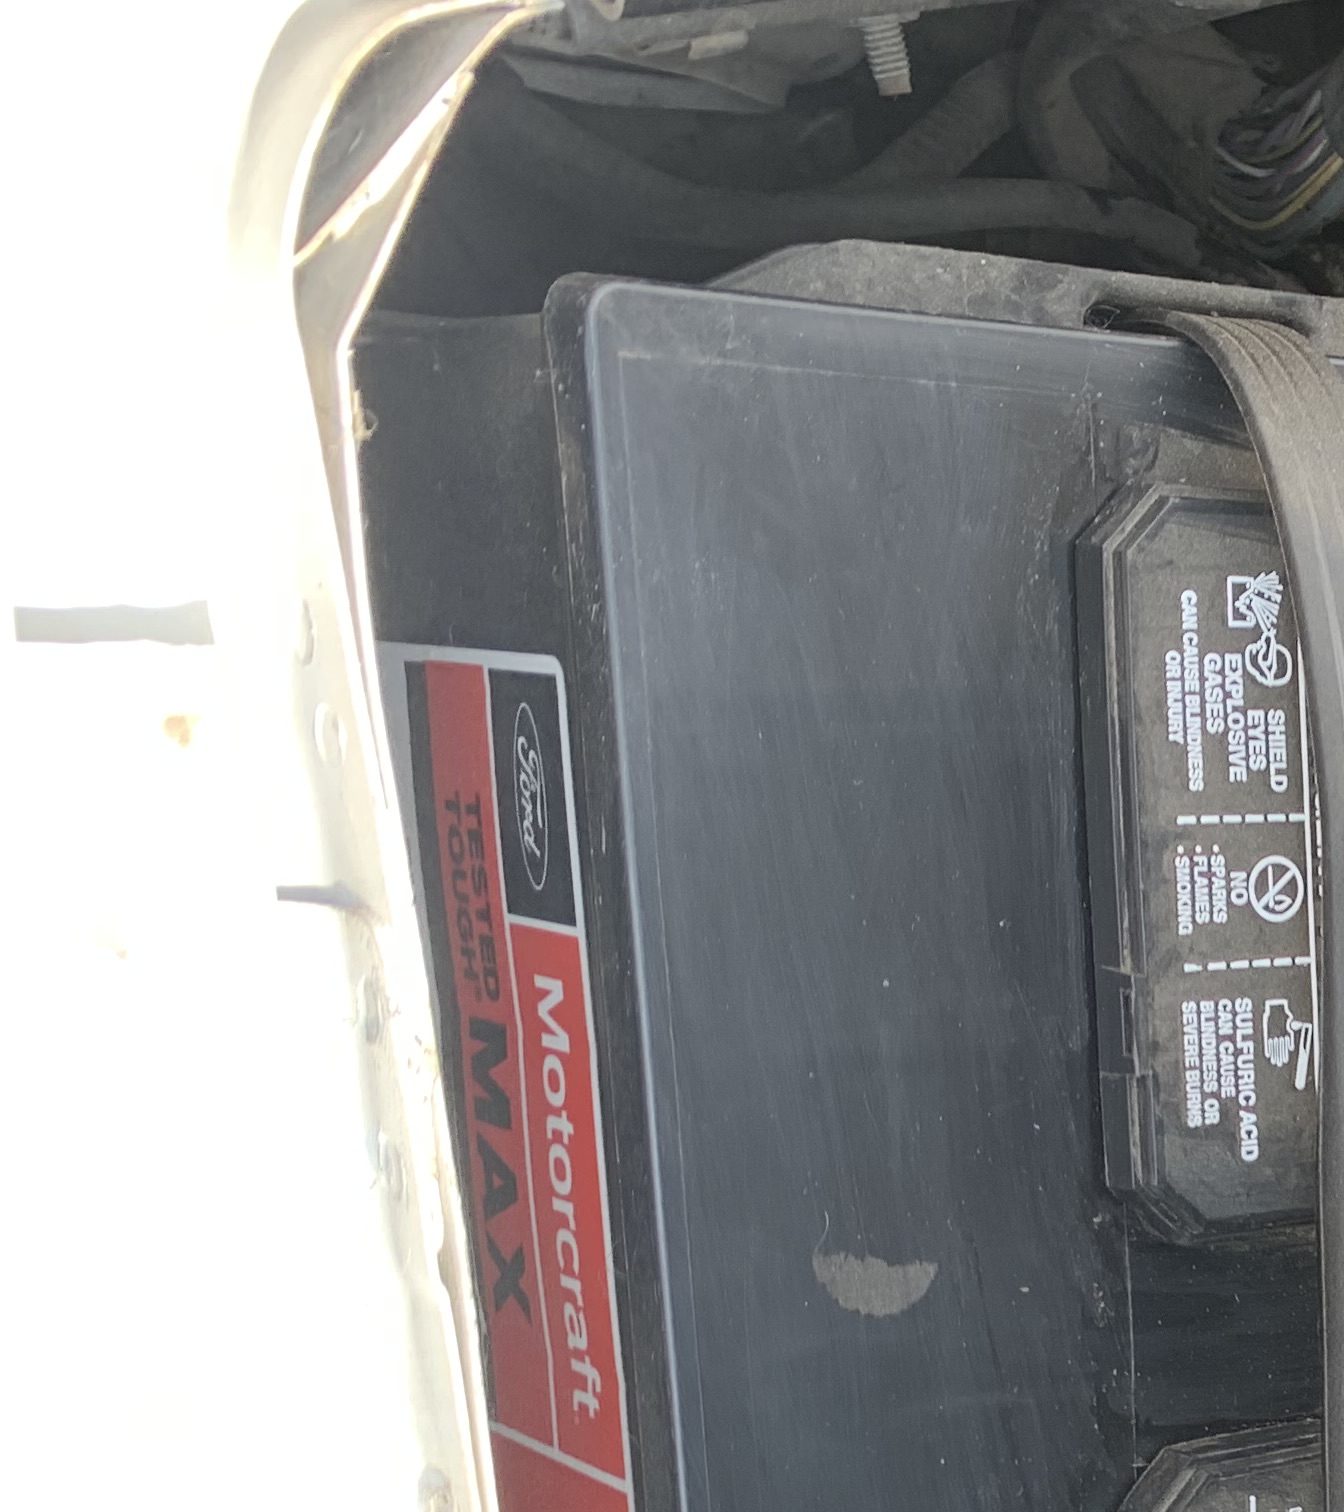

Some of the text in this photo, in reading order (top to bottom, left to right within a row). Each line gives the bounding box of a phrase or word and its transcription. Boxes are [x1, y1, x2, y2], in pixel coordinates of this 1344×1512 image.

[1165, 650, 1184, 745] OR INJURY
[1180, 590, 1204, 792] CAN CAUSE BLINDNESS
[1203, 652, 1224, 734] GASES
[1224, 652, 1247, 784] EXPLOSIVE
[1246, 708, 1267, 772] EYES
[1268, 708, 1288, 794] SHIELD
[464, 799, 502, 1001] TESTED
[1174, 855, 1192, 936] SMOKING
[1192, 855, 1210, 924] FLAMES
[1210, 854, 1228, 924] SPARKS
[1230, 871, 1248, 906] NO
[514, 735, 603, 1419] Ford Motorcraft
[1181, 1000, 1202, 1128] SEVERE BURNS
[1200, 1000, 1220, 1125] BLINDNESS OR
[1218, 998, 1235, 1098] CAN CAUSE
[1234, 997, 1259, 1162] SULFURIC ACID
[467, 1017, 533, 1315] MAX
